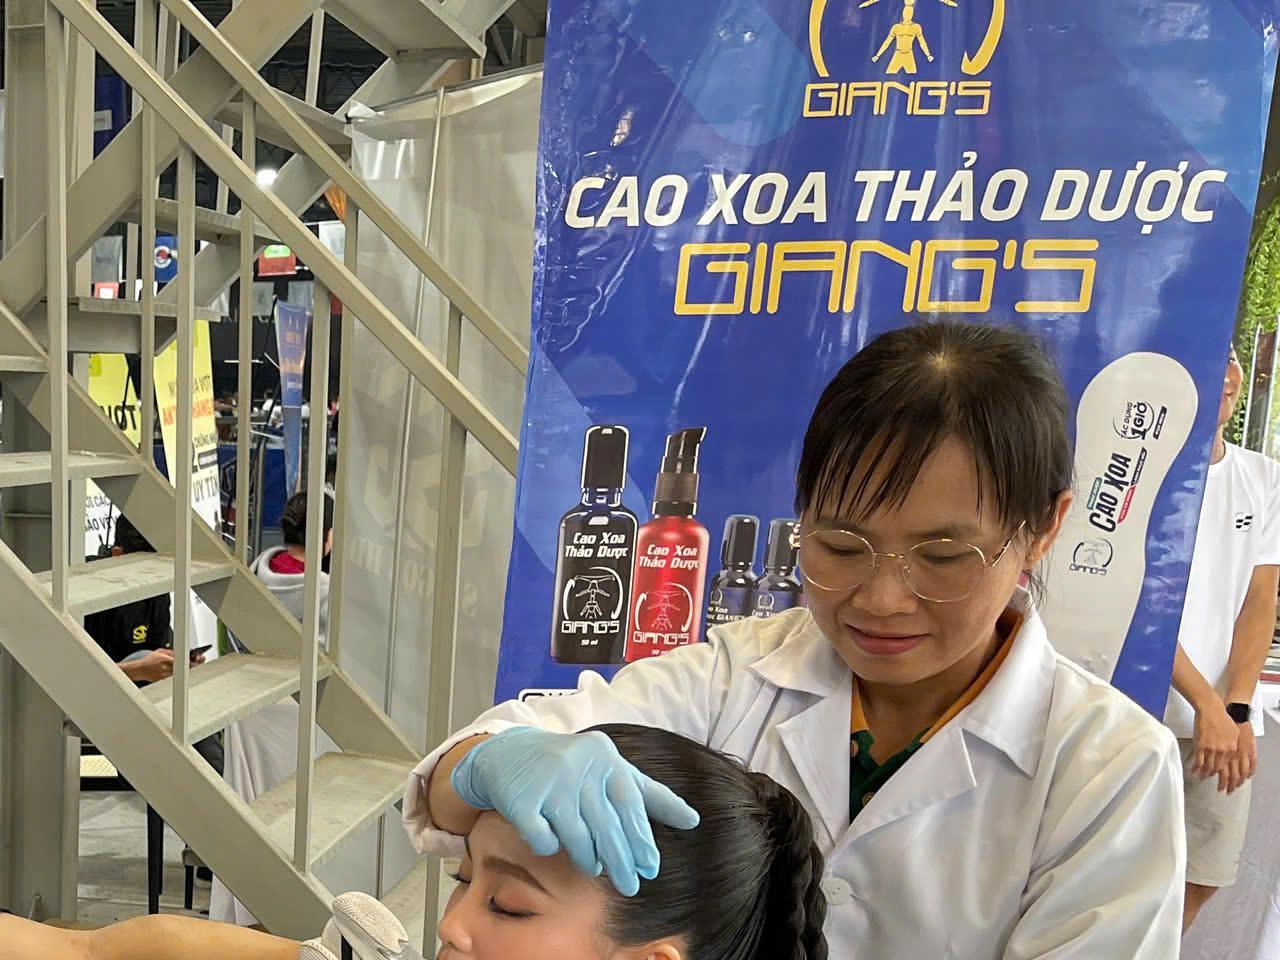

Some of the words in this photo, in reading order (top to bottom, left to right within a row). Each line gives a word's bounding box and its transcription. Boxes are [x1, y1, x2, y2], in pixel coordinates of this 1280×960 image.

[803, 81, 991, 117] GIANG'S
[564, 175, 686, 230] CAO
[696, 172, 827, 226] XOA
[853, 151, 1027, 223] THẢO
[1040, 161, 1227, 235] DƯỢC
[674, 239, 1099, 316] GIANG'S
[1103, 452, 1131, 492] XOA
[1089, 491, 1118, 532] CAO
[573, 532, 596, 544] Cao
[600, 532, 626, 544] Xoa
[647, 544, 669, 556] Cao
[673, 545, 698, 557] Xoa
[565, 545, 593, 558] Thảo
[597, 546, 629, 559] Dược
[639, 556, 667, 569] Thảo
[561, 620, 620, 634] GIANG'S
